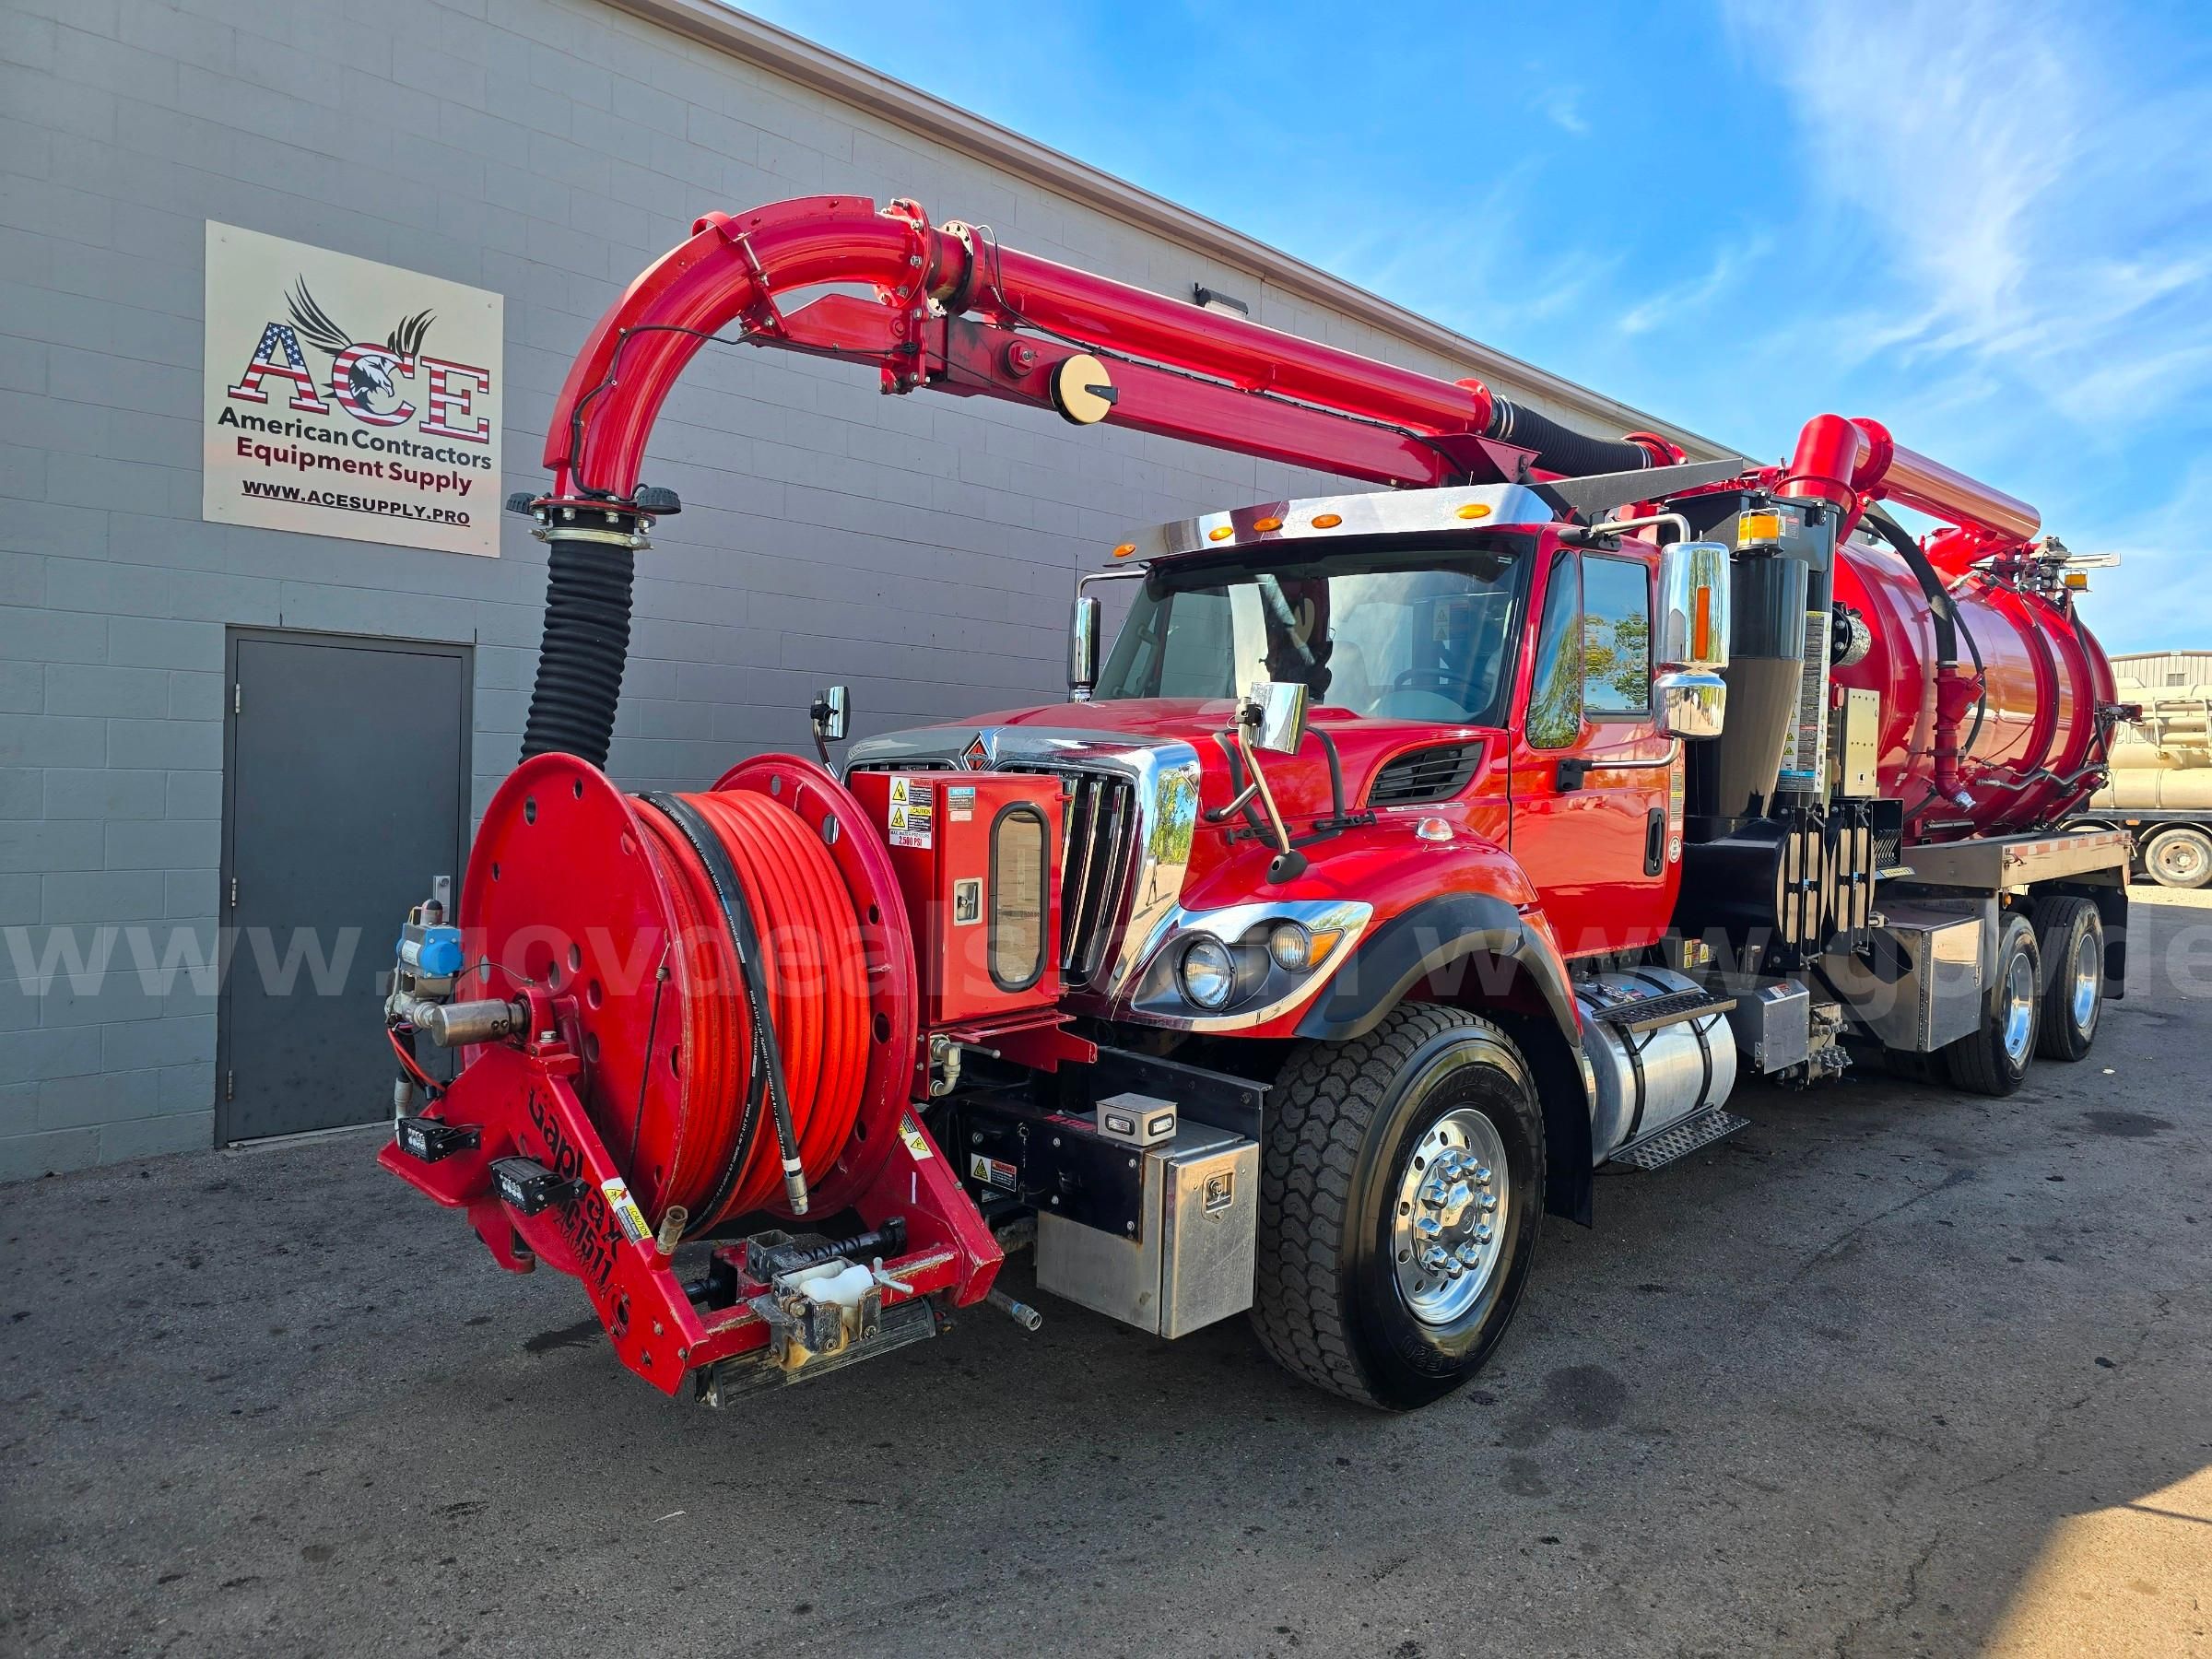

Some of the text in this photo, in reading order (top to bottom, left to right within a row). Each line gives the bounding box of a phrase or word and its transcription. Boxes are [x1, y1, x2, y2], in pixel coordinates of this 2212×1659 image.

[228, 322, 489, 444] ACE
[218, 406, 492, 470] American Contractors
[237, 437, 473, 497] Equipment Supply
[242, 480, 471, 525] WWW.ACESUPPLY.PRO
[913, 837, 923, 847] PSI
[632, 1210, 650, 1237] CAUTION
